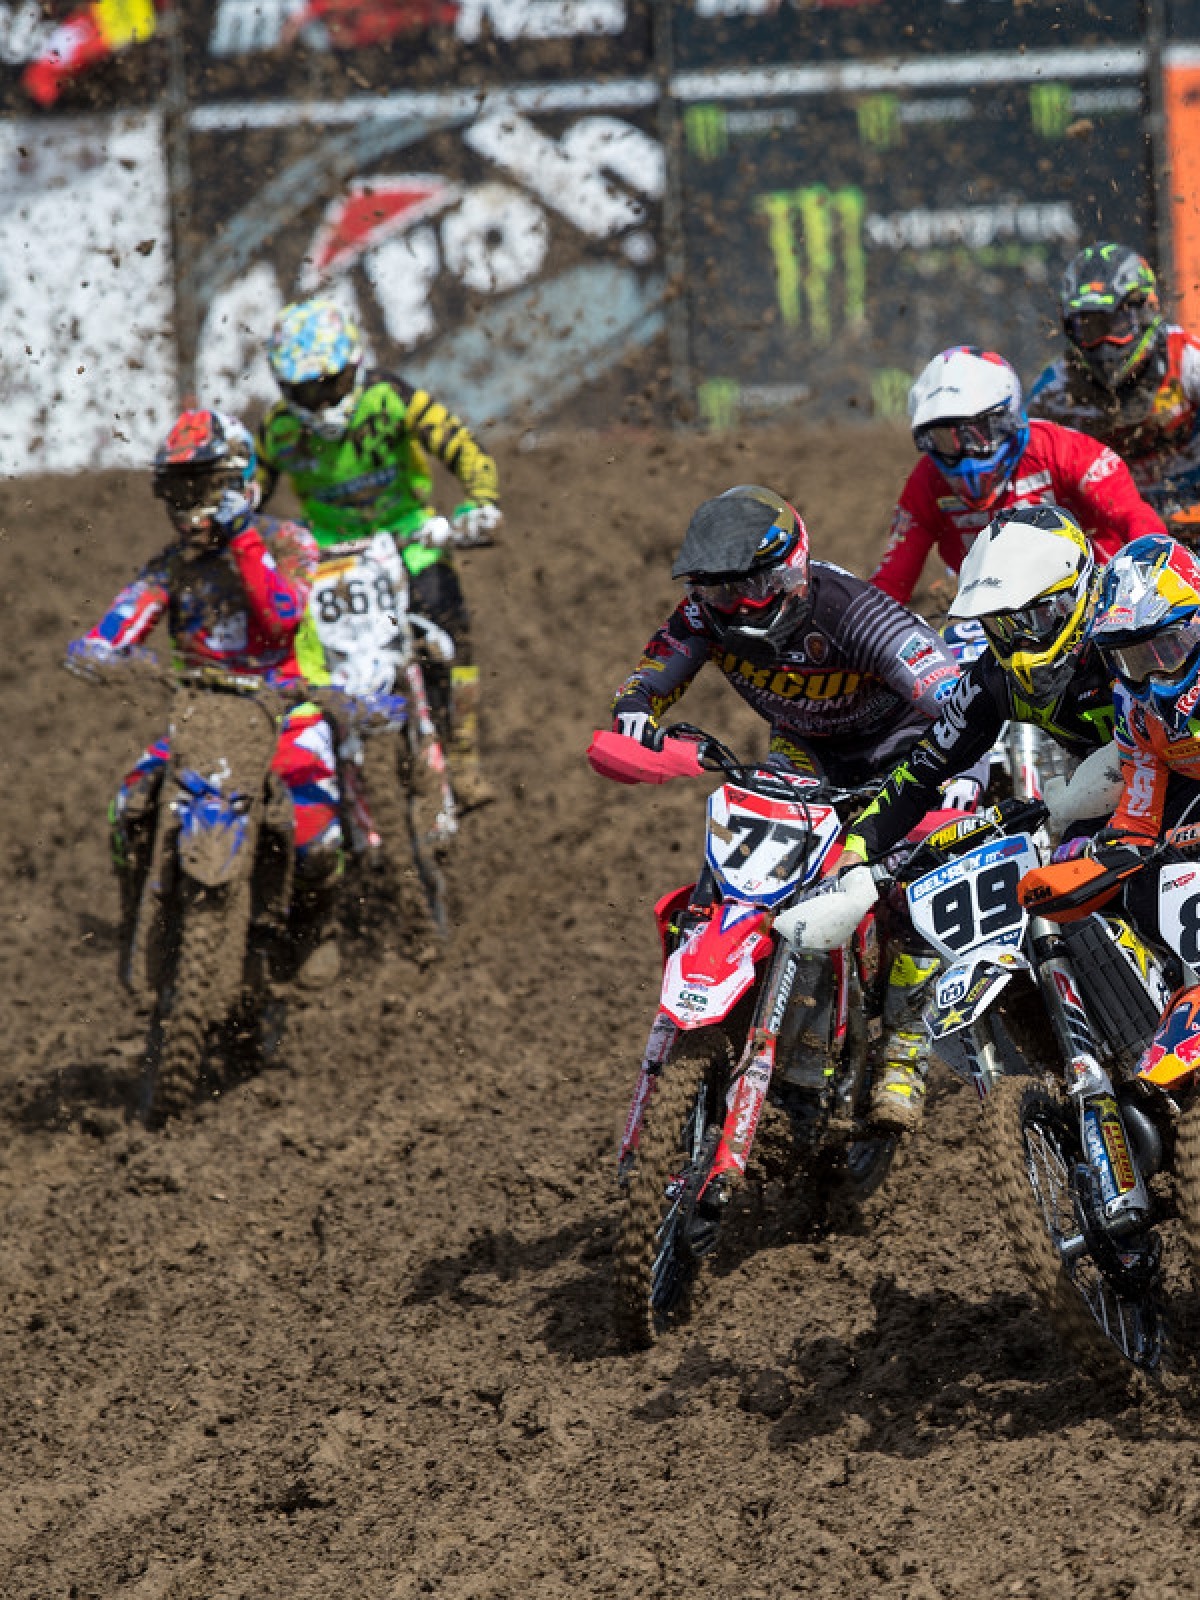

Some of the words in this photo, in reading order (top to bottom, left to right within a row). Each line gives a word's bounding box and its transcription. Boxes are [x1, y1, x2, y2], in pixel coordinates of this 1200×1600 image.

[315, 575, 396, 623] 868
[722, 814, 822, 879] 77
[933, 860, 1021, 951] 99
[1024, 885, 1053, 904] KTM
